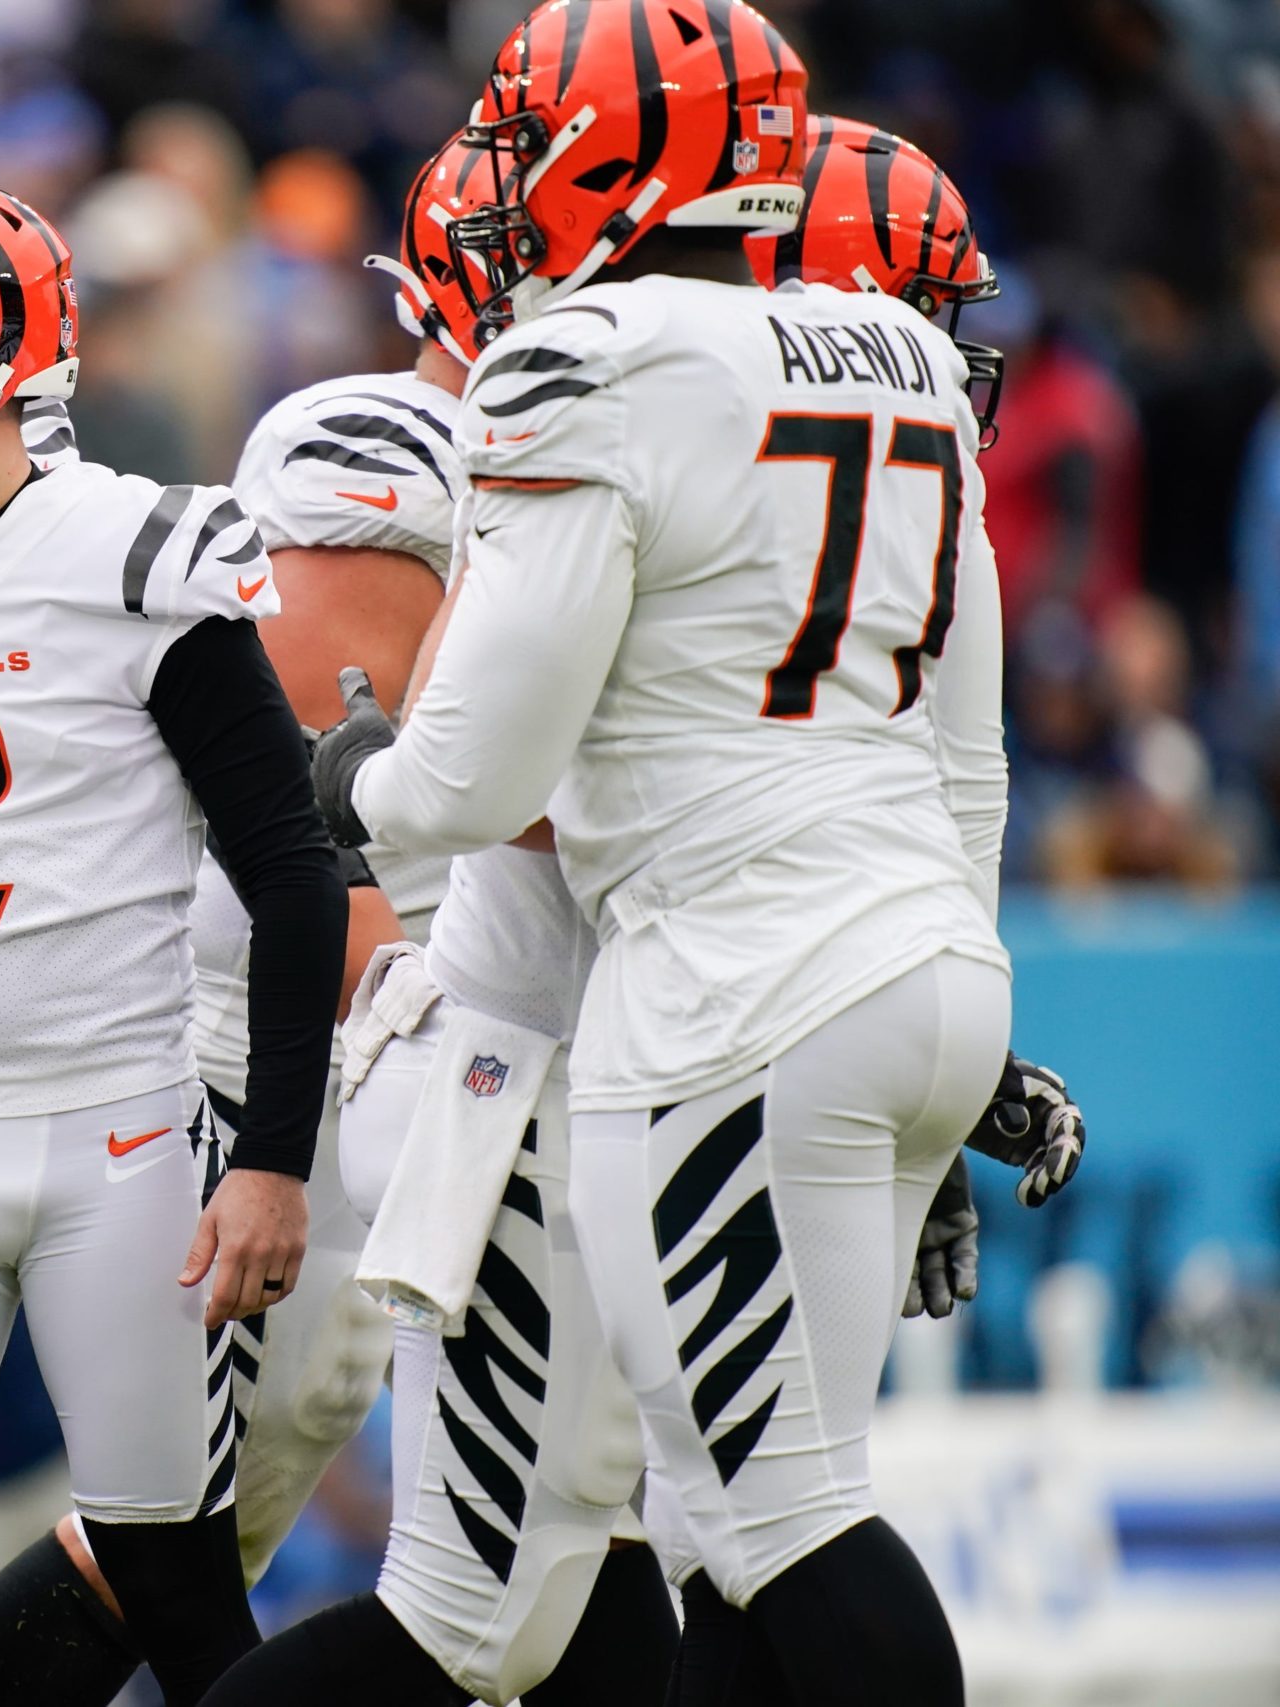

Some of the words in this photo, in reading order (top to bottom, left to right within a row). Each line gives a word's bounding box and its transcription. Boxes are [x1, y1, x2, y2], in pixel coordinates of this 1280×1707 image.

[767, 315, 936, 397] ADENIJI
[755, 411, 964, 720] 77
[467, 1070, 497, 1093] NFL
